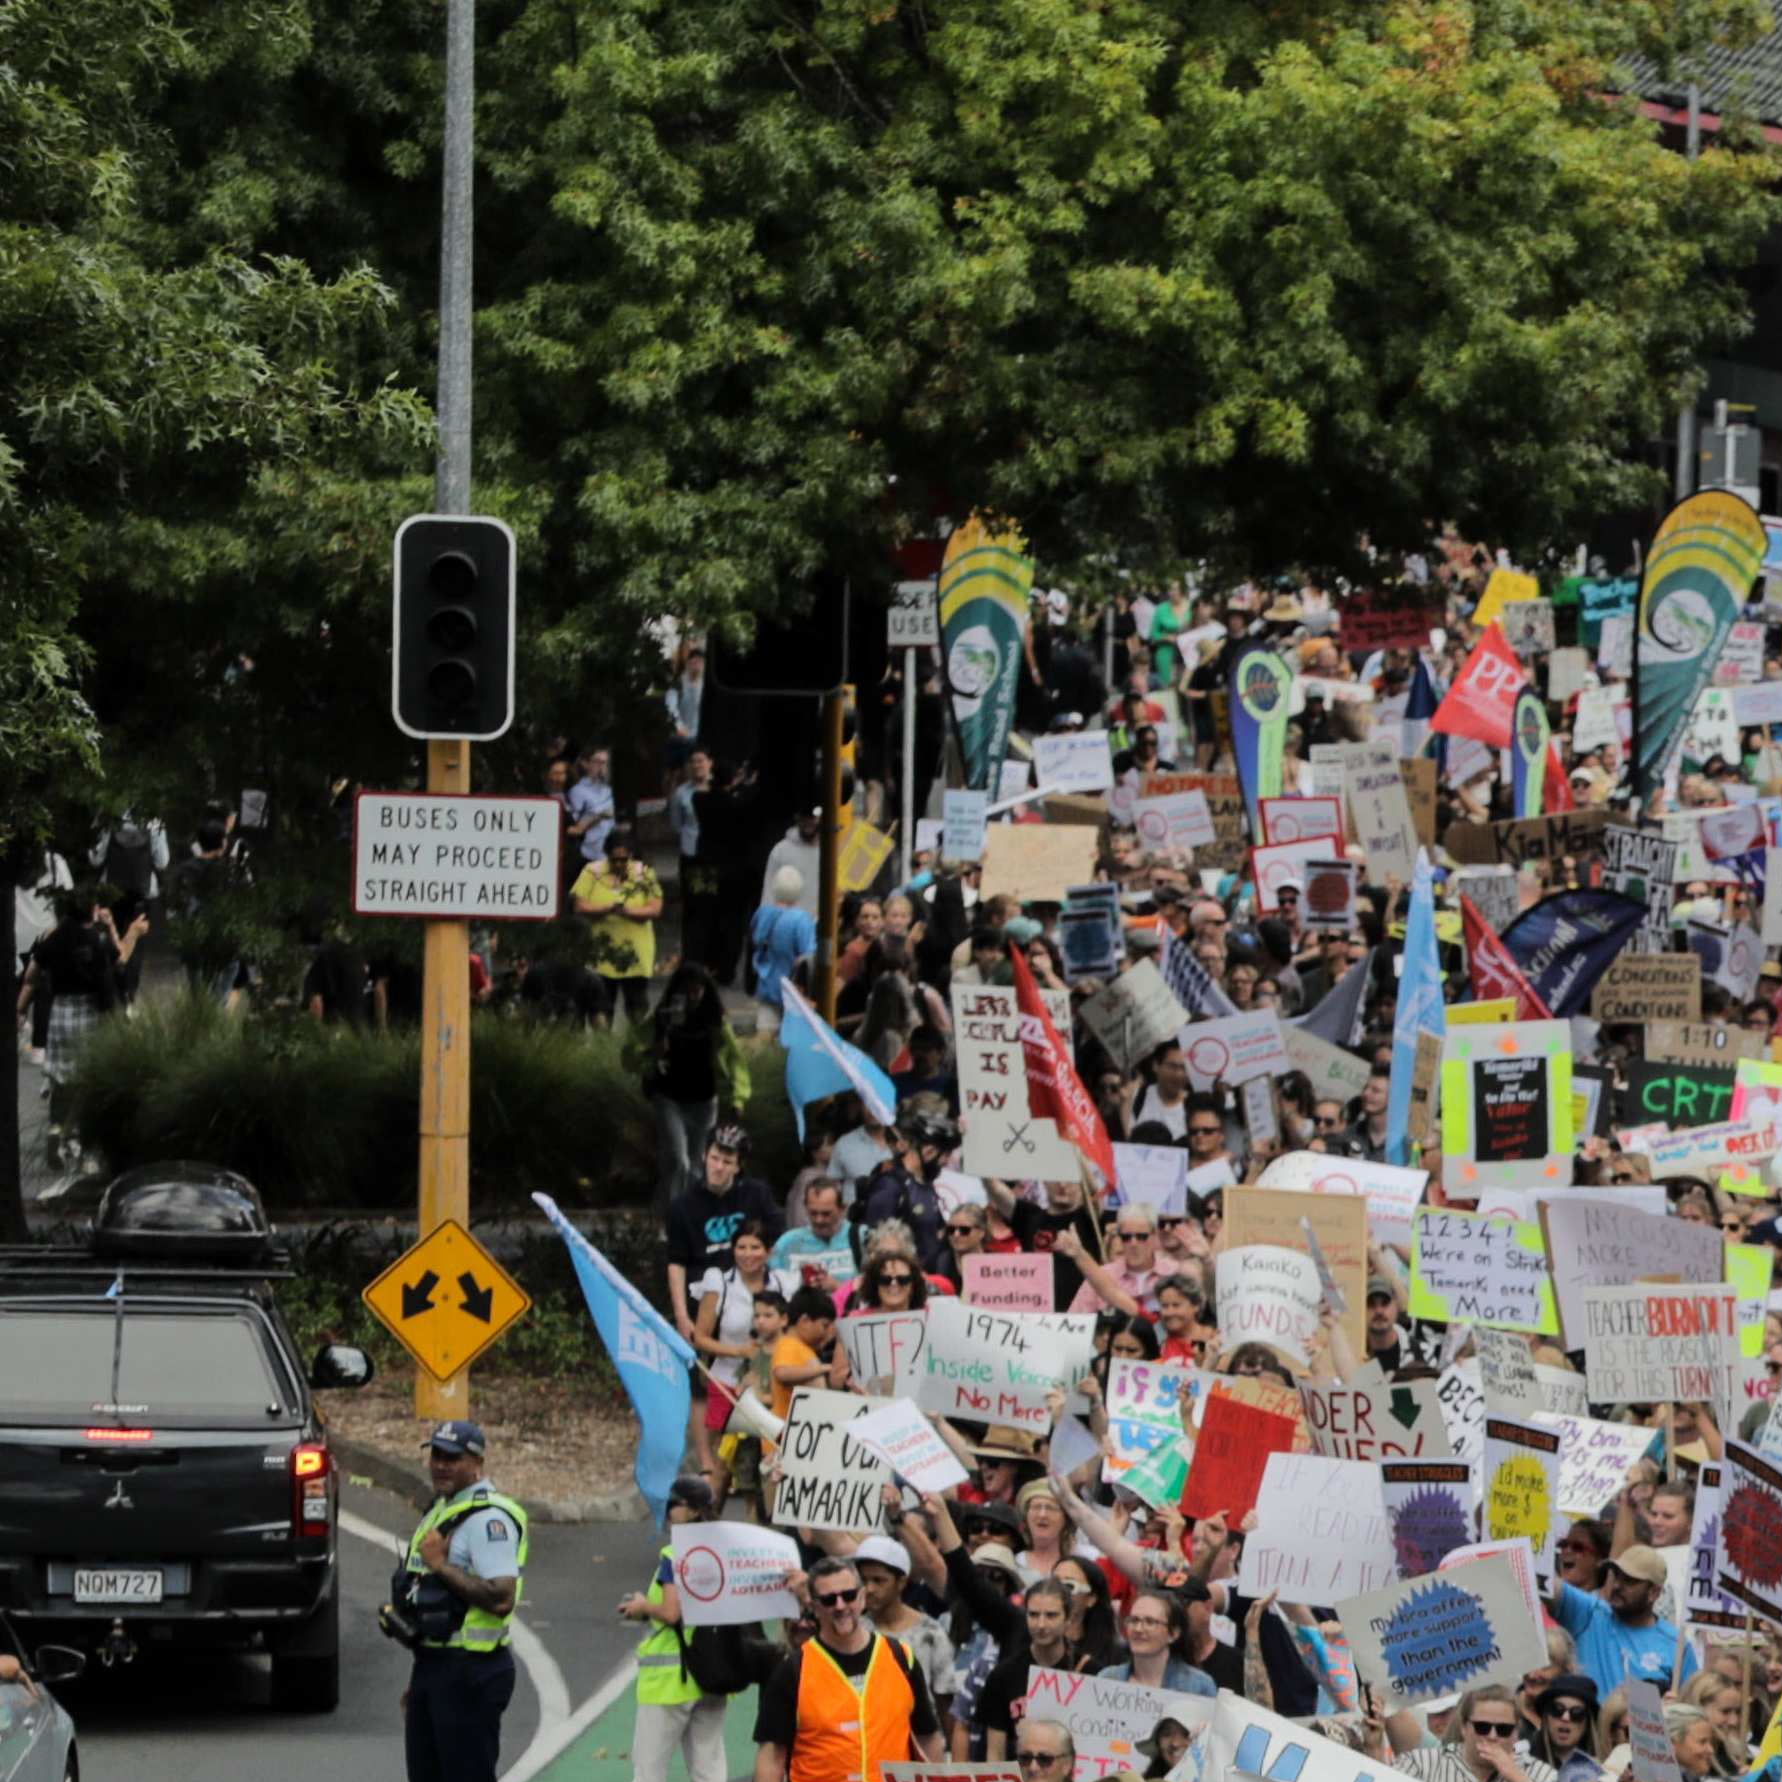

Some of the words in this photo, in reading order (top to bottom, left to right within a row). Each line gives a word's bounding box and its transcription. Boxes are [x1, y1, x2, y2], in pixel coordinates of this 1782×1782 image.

[380, 806, 459, 830] BUSES
[474, 808, 537, 832] ONLY
[371, 843, 423, 868] MAY
[435, 845, 543, 870] PROCEED
[363, 880, 467, 904] STRAIGHT
[473, 881, 550, 906] AHEAD
[1642, 1076, 1733, 1115] CRT
[979, 1265, 1039, 1279] Better
[77, 1576, 159, 1595] NQM727
[1400, 1610, 1428, 1624] bra
[1432, 1594, 1483, 1614] offers
[1380, 1629, 1421, 1646] more
[1423, 1607, 1486, 1635] support
[1401, 1646, 1445, 1667] than
[1449, 1634, 1478, 1651] the
[1392, 1647, 1502, 1694] government
